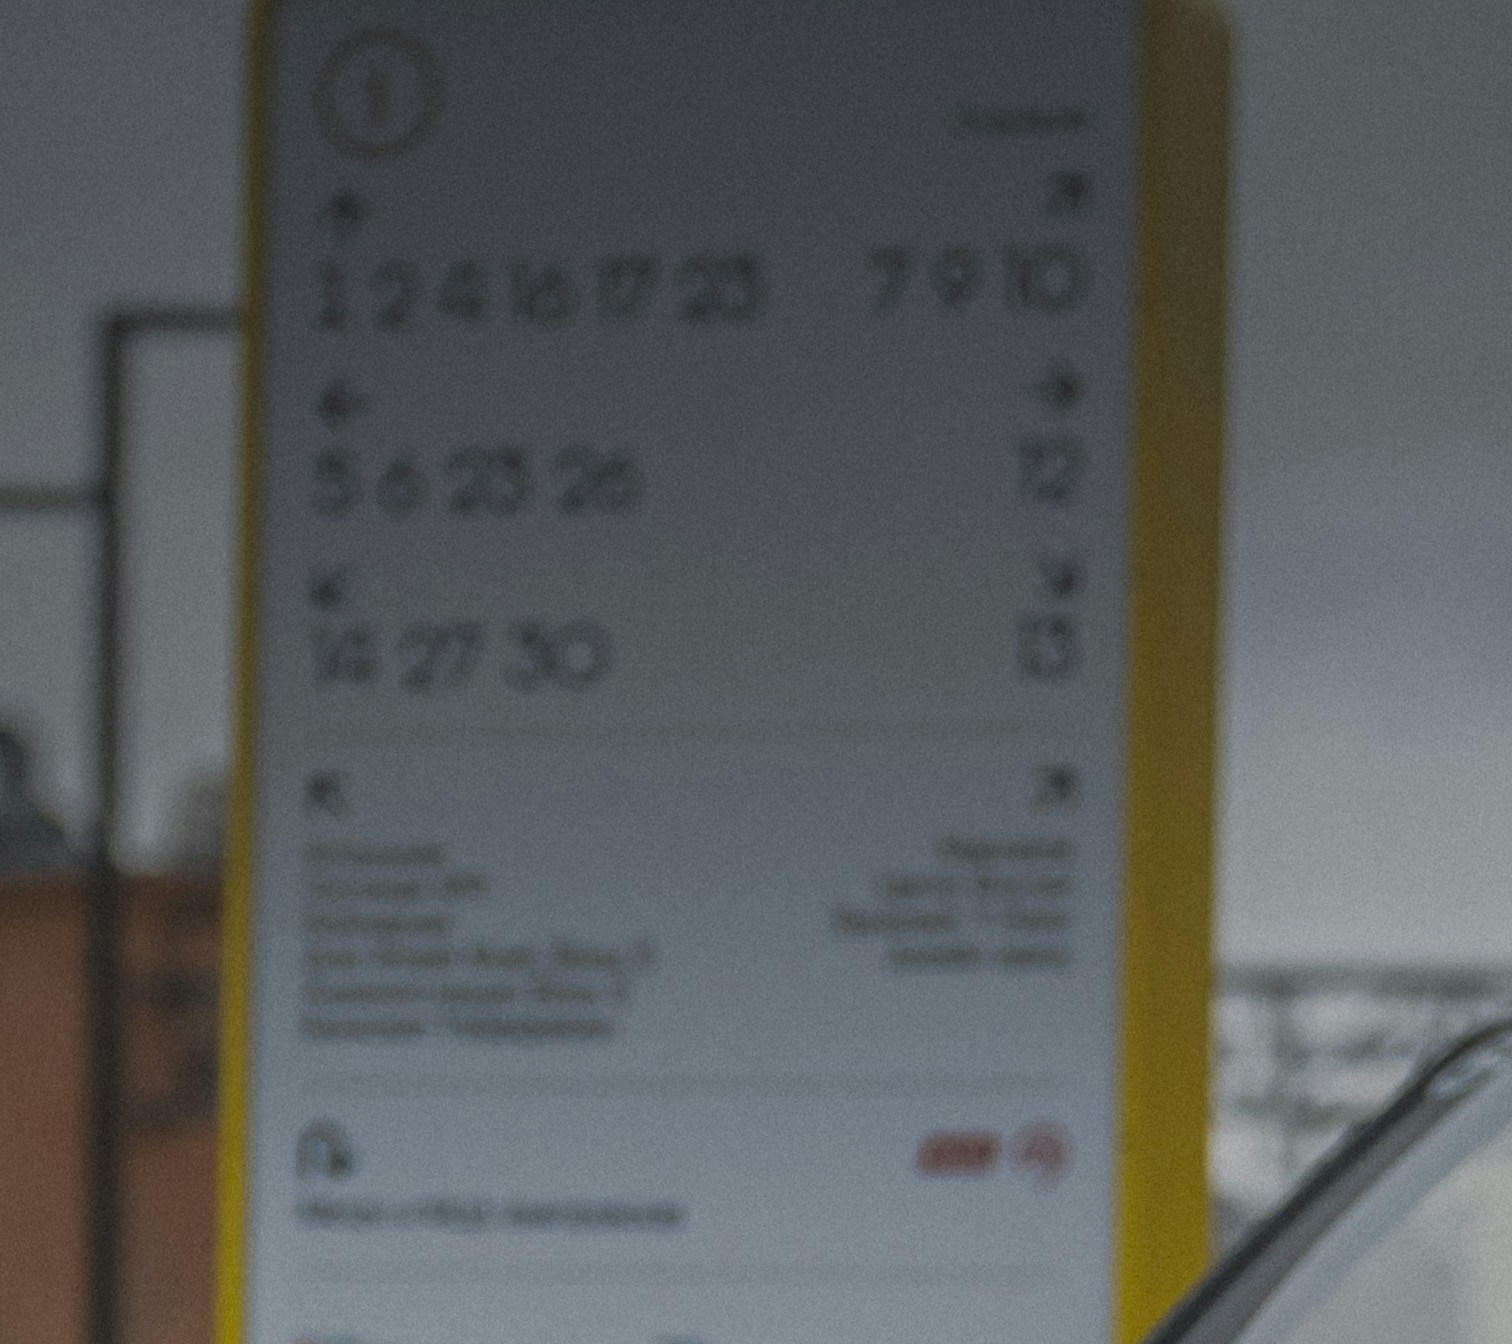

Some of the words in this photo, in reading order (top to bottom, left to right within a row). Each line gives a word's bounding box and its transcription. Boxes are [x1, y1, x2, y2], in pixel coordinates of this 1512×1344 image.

[372, 260, 423, 333] 2
[437, 256, 489, 326] 4
[867, 245, 916, 315] 7
[931, 245, 984, 314] 9
[1003, 244, 1092, 315] 10
[379, 450, 428, 519] 6
[506, 620, 613, 690] 30
